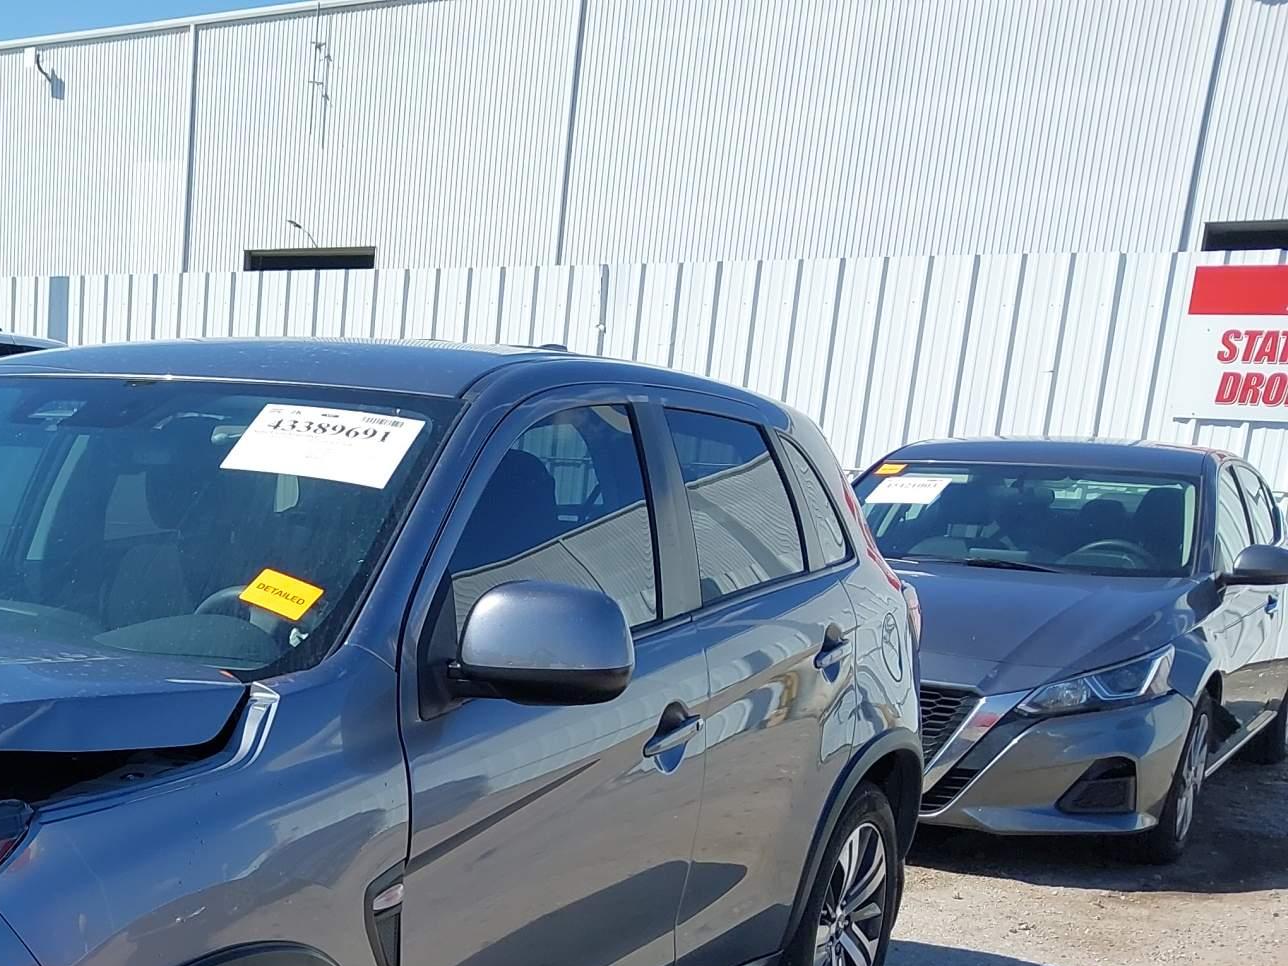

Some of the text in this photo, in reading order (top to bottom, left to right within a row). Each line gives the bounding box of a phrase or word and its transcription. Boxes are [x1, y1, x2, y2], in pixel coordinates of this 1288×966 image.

[1215, 371, 1288, 407] DRO
[267, 418, 391, 443] 43389691
[255, 582, 306, 606] DETAILED
